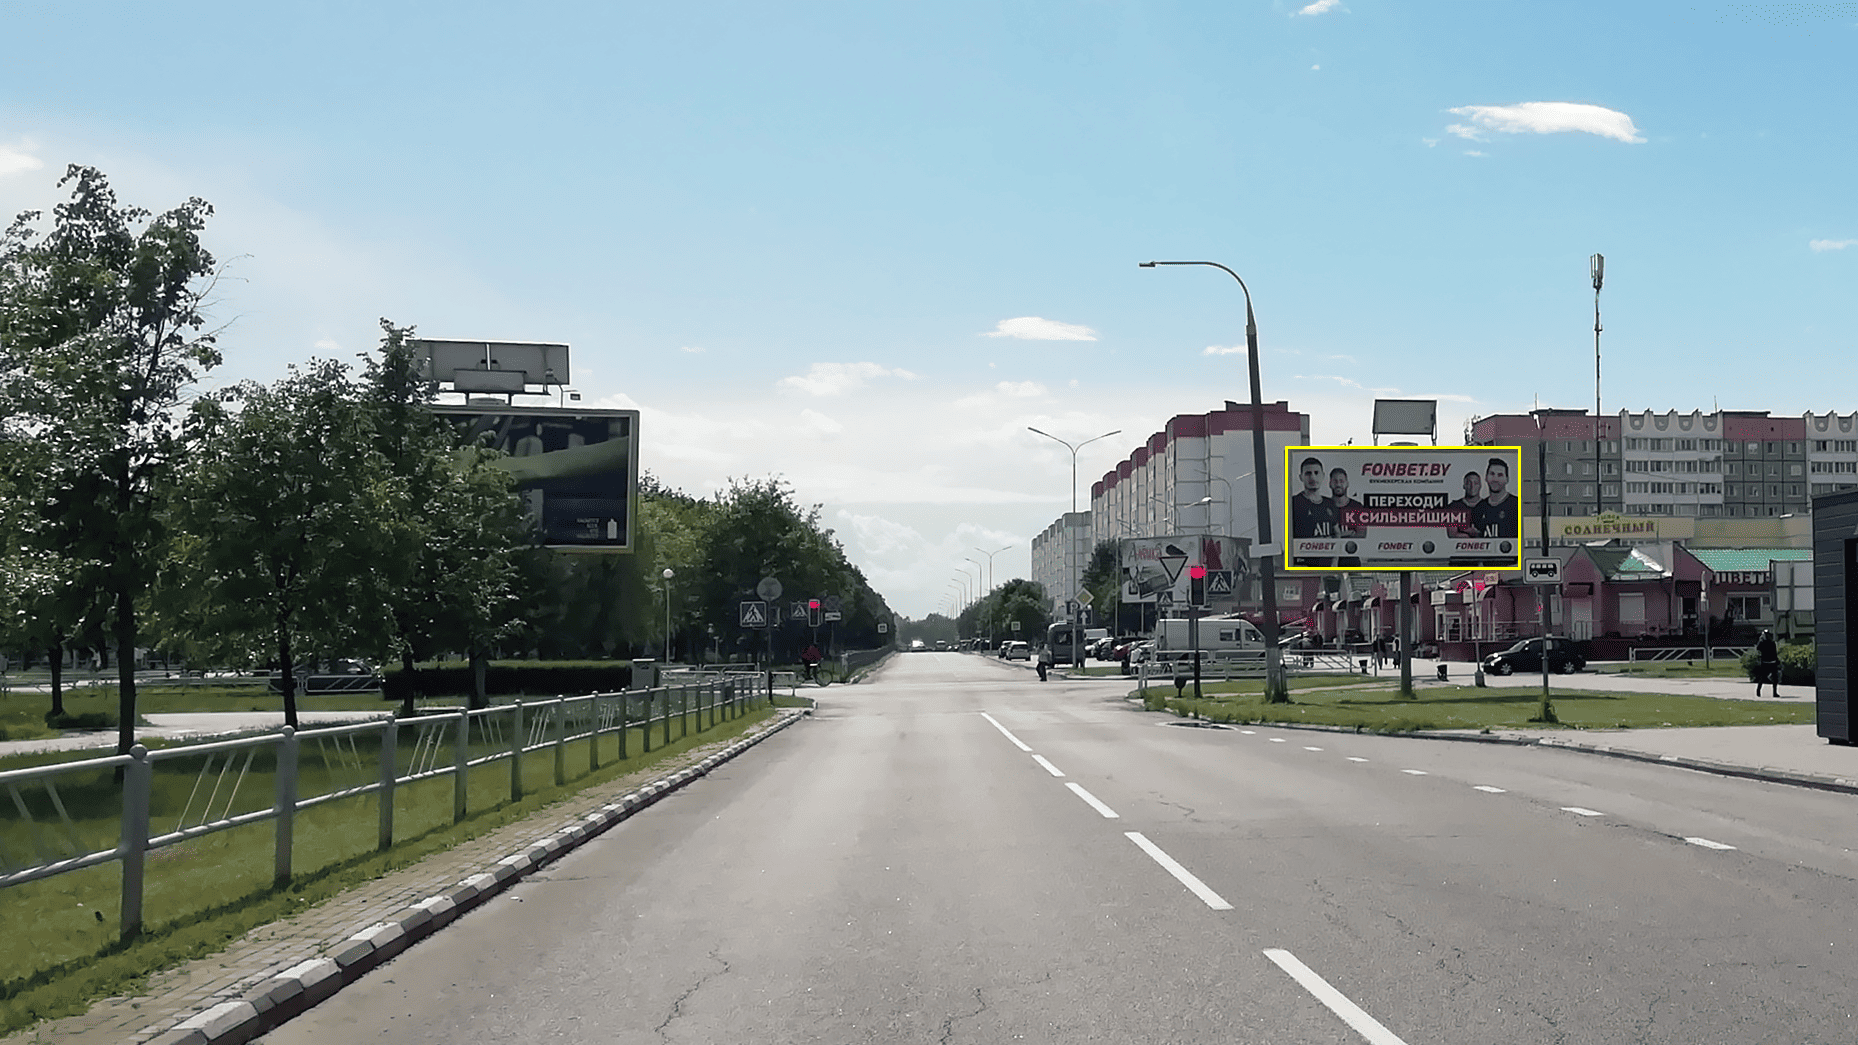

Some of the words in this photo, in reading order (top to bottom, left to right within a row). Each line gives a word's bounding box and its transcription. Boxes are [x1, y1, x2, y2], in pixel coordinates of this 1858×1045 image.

[1361, 463, 1451, 476] FONBET.BY
[1369, 496, 1444, 509] ПЕРЕХОДИ
[1345, 512, 1356, 523] К
[1359, 509, 1467, 523] СИЛЬНЕЙШИМ!
[1564, 520, 1654, 535] СОЛНЕЧНЫЙ
[1299, 542, 1336, 550] FONBET
[1377, 542, 1414, 550] FONBET
[1455, 542, 1491, 550] FONBET
